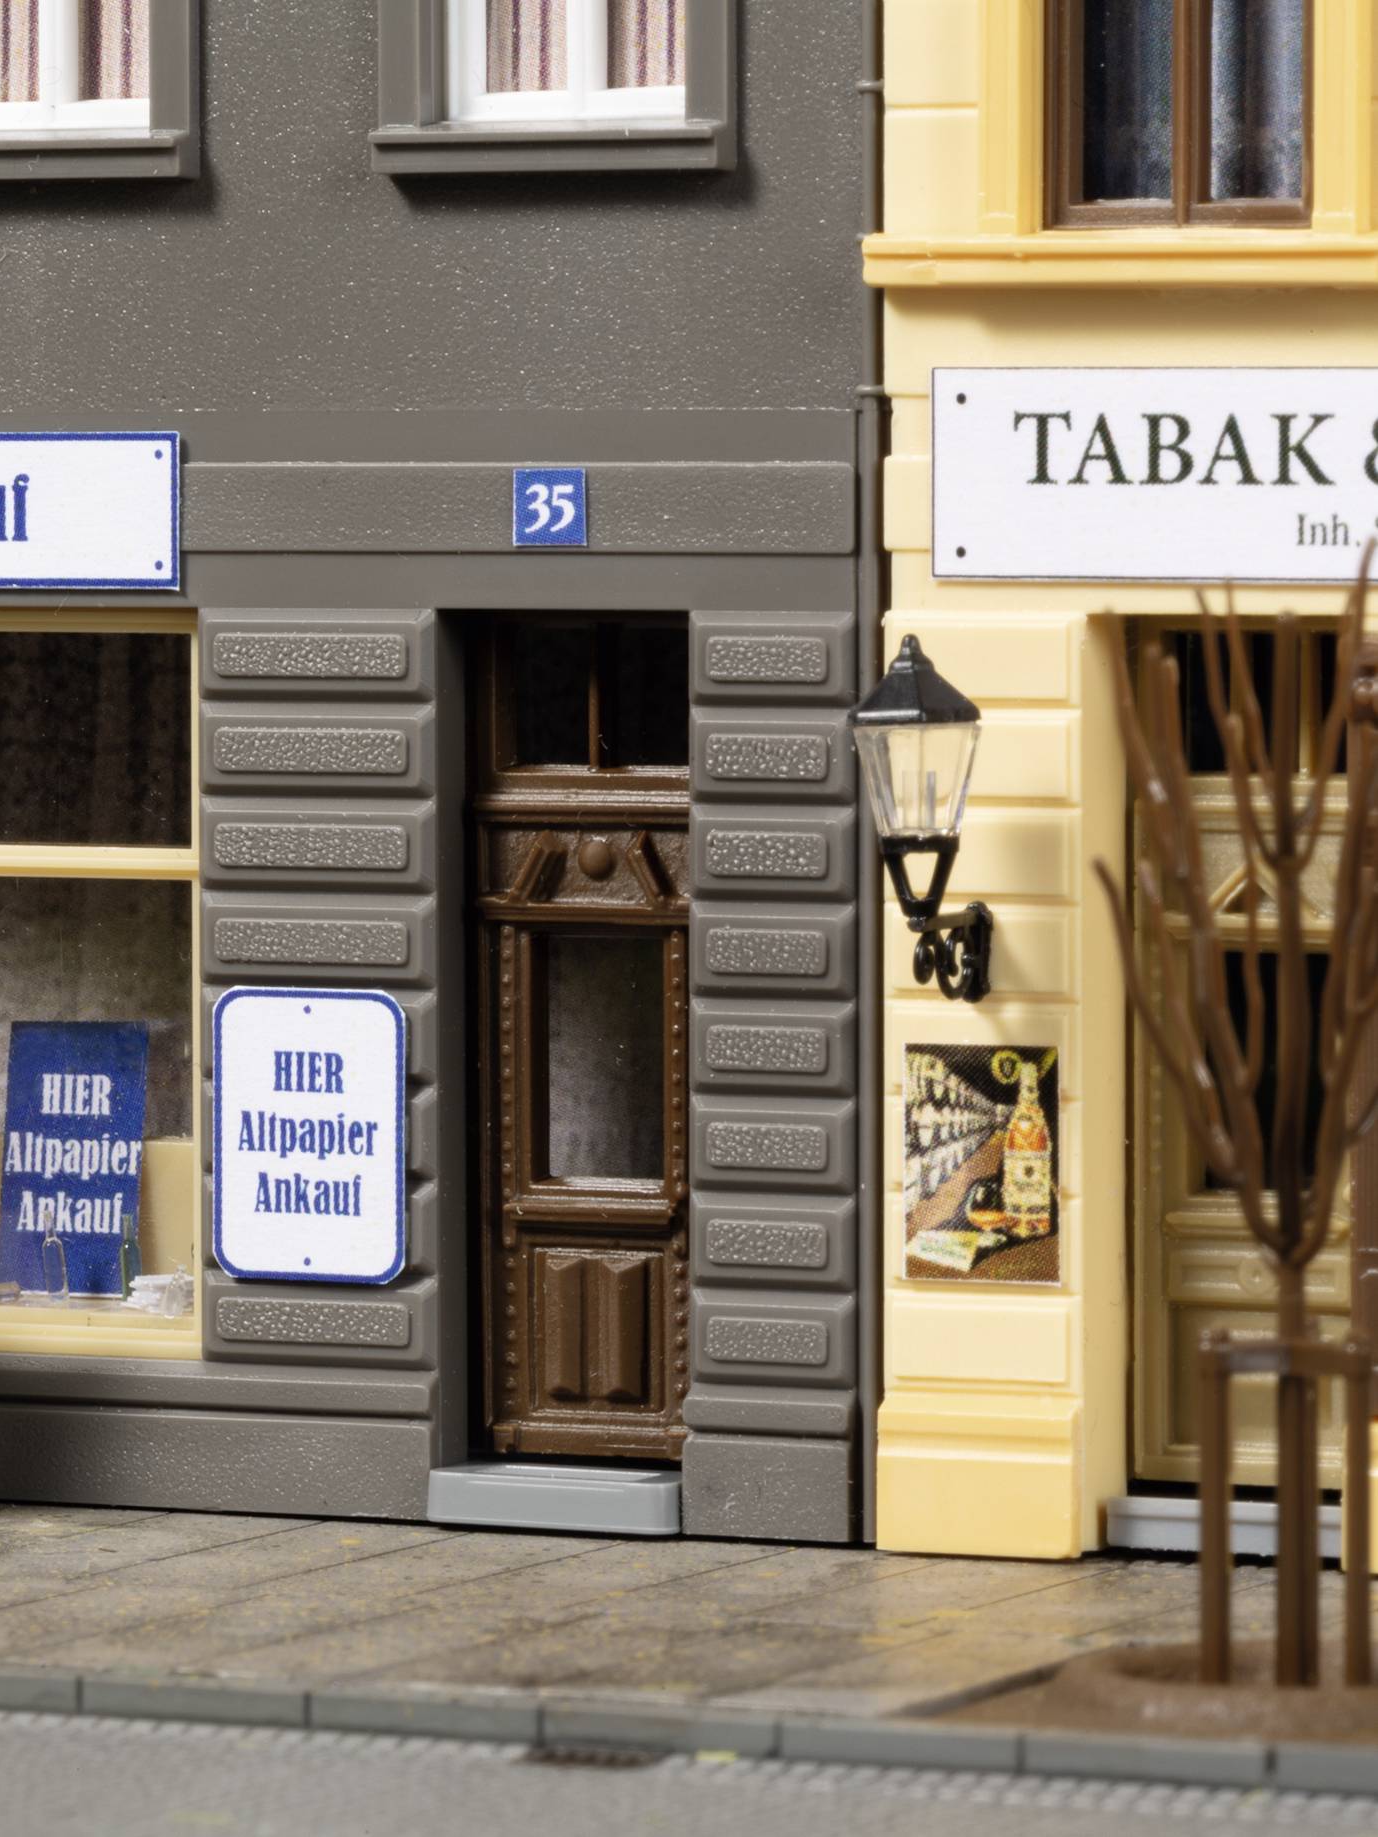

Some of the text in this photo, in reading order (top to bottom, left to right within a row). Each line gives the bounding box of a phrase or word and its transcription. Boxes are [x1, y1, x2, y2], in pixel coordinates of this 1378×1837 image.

[1013, 411, 1336, 486] TABAK
[525, 483, 575, 534] 35
[1296, 513, 1362, 547] Inh.
[40, 1073, 112, 1116] HIER
[273, 1050, 344, 1094] HIER
[5, 1131, 142, 1180] Altpapier
[238, 1110, 378, 1160] Altpapier
[16, 1190, 124, 1234] Ankauf
[254, 1171, 362, 1217] Ankauf
